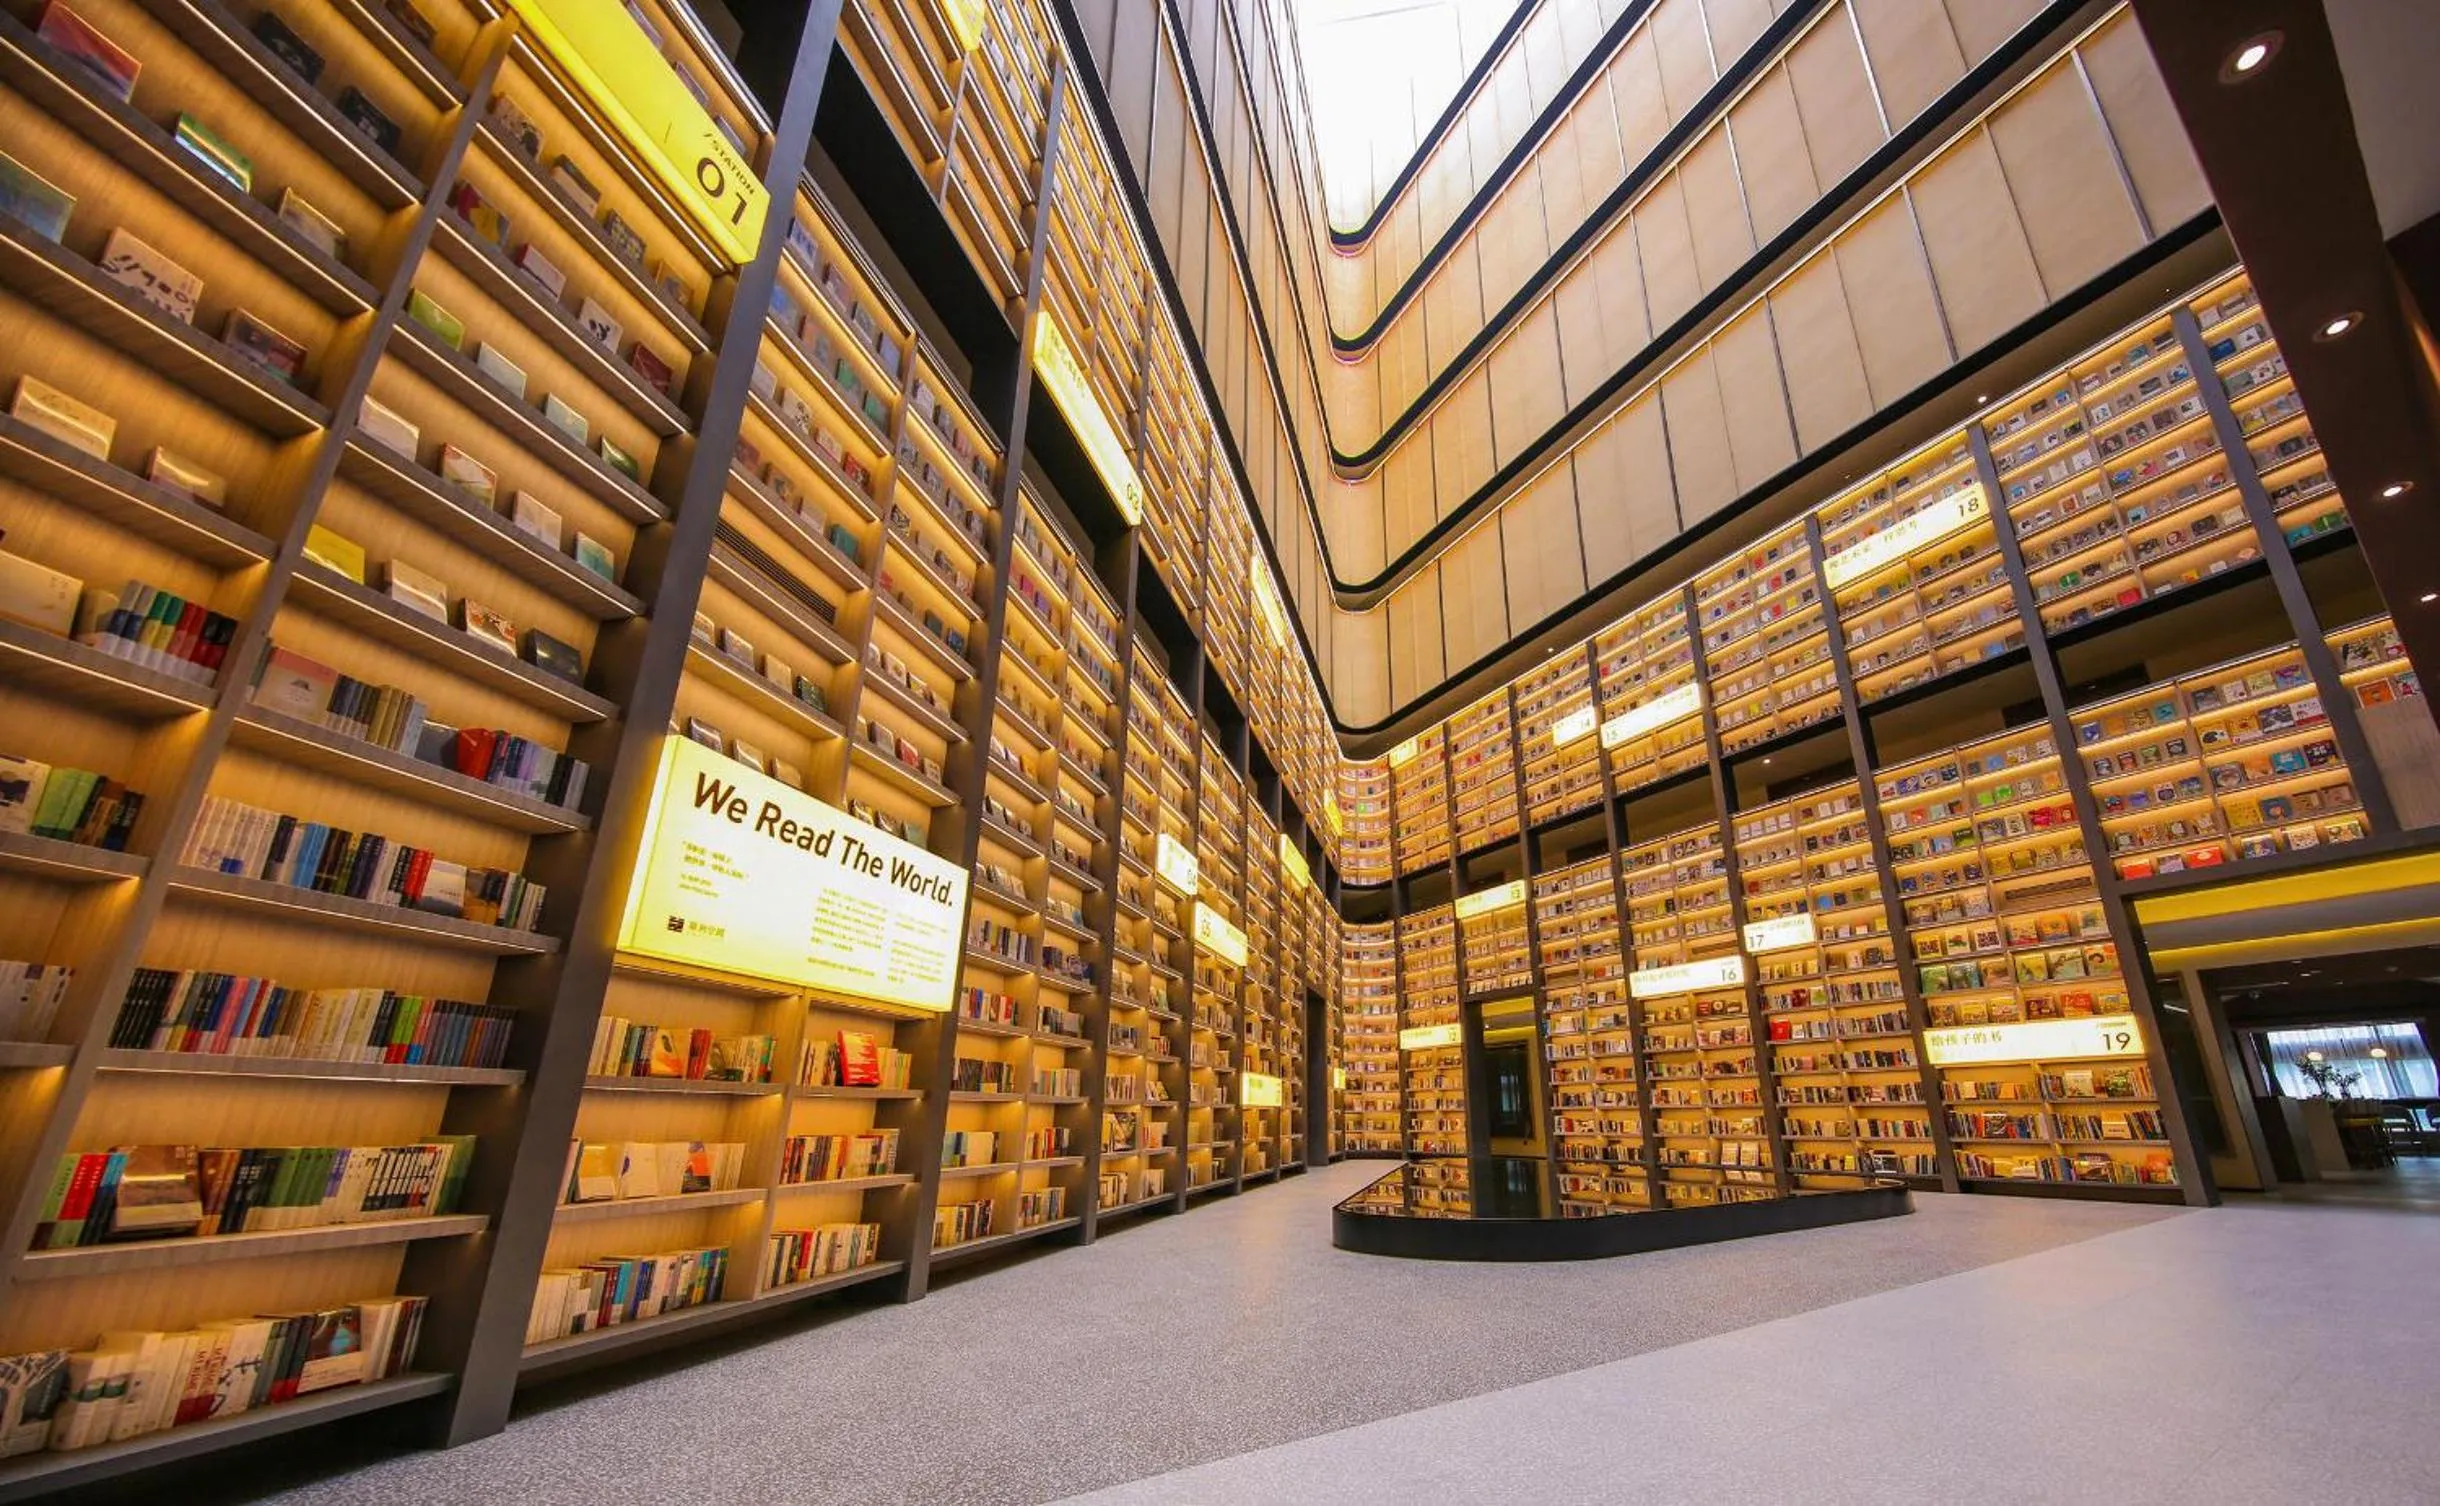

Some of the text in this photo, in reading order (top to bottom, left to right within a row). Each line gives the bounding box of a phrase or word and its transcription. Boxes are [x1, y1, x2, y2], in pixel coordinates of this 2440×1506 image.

[696, 157, 747, 226] 01
[1958, 496, 1980, 518] 18
[693, 771, 748, 825] We
[754, 801, 835, 859] Read
[840, 834, 884, 878] The
[889, 856, 954, 907] World.
[1748, 934, 1765, 948] 17
[1720, 970, 1737, 983] 16
[2102, 1032, 2131, 1051] 19
